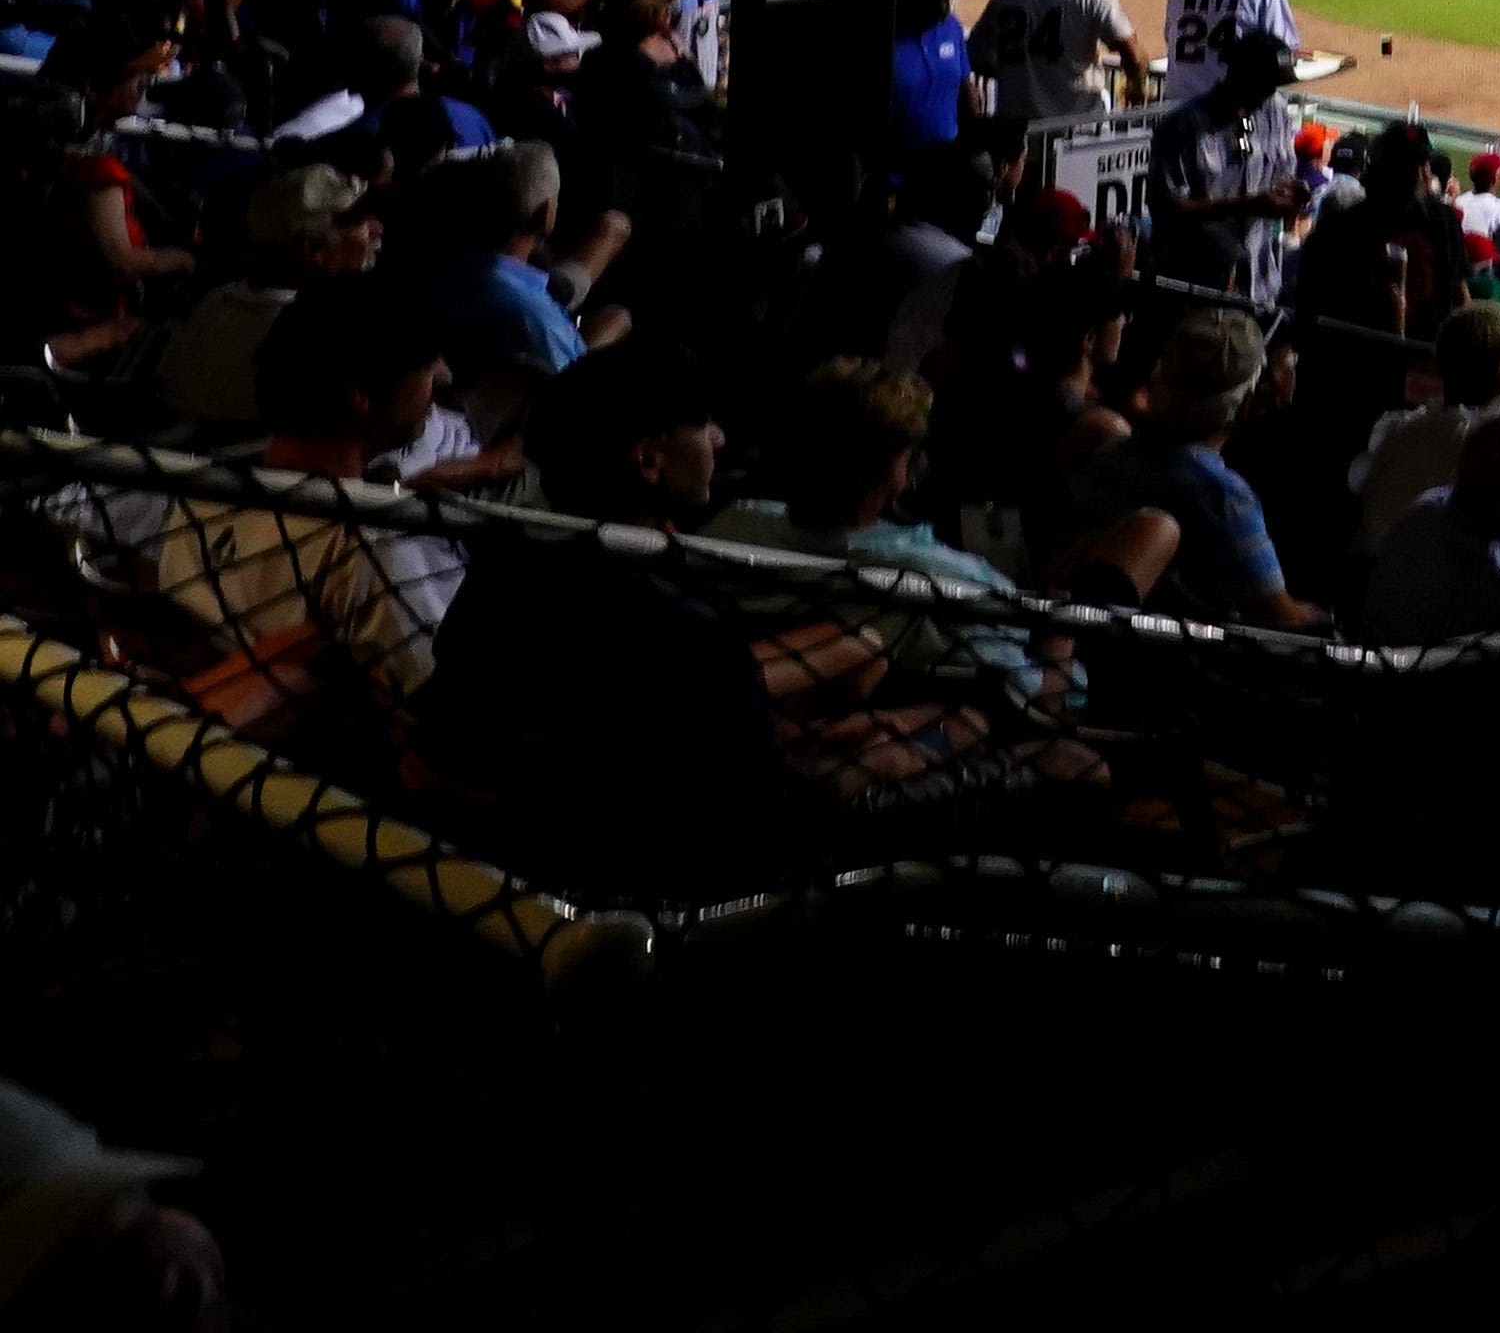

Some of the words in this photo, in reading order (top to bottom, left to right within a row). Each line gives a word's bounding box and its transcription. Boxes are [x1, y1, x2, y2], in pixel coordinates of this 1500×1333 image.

[1000, 4, 1064, 63] 24
[1175, 15, 1240, 63] 24
[1097, 146, 1149, 174] SECTIO
